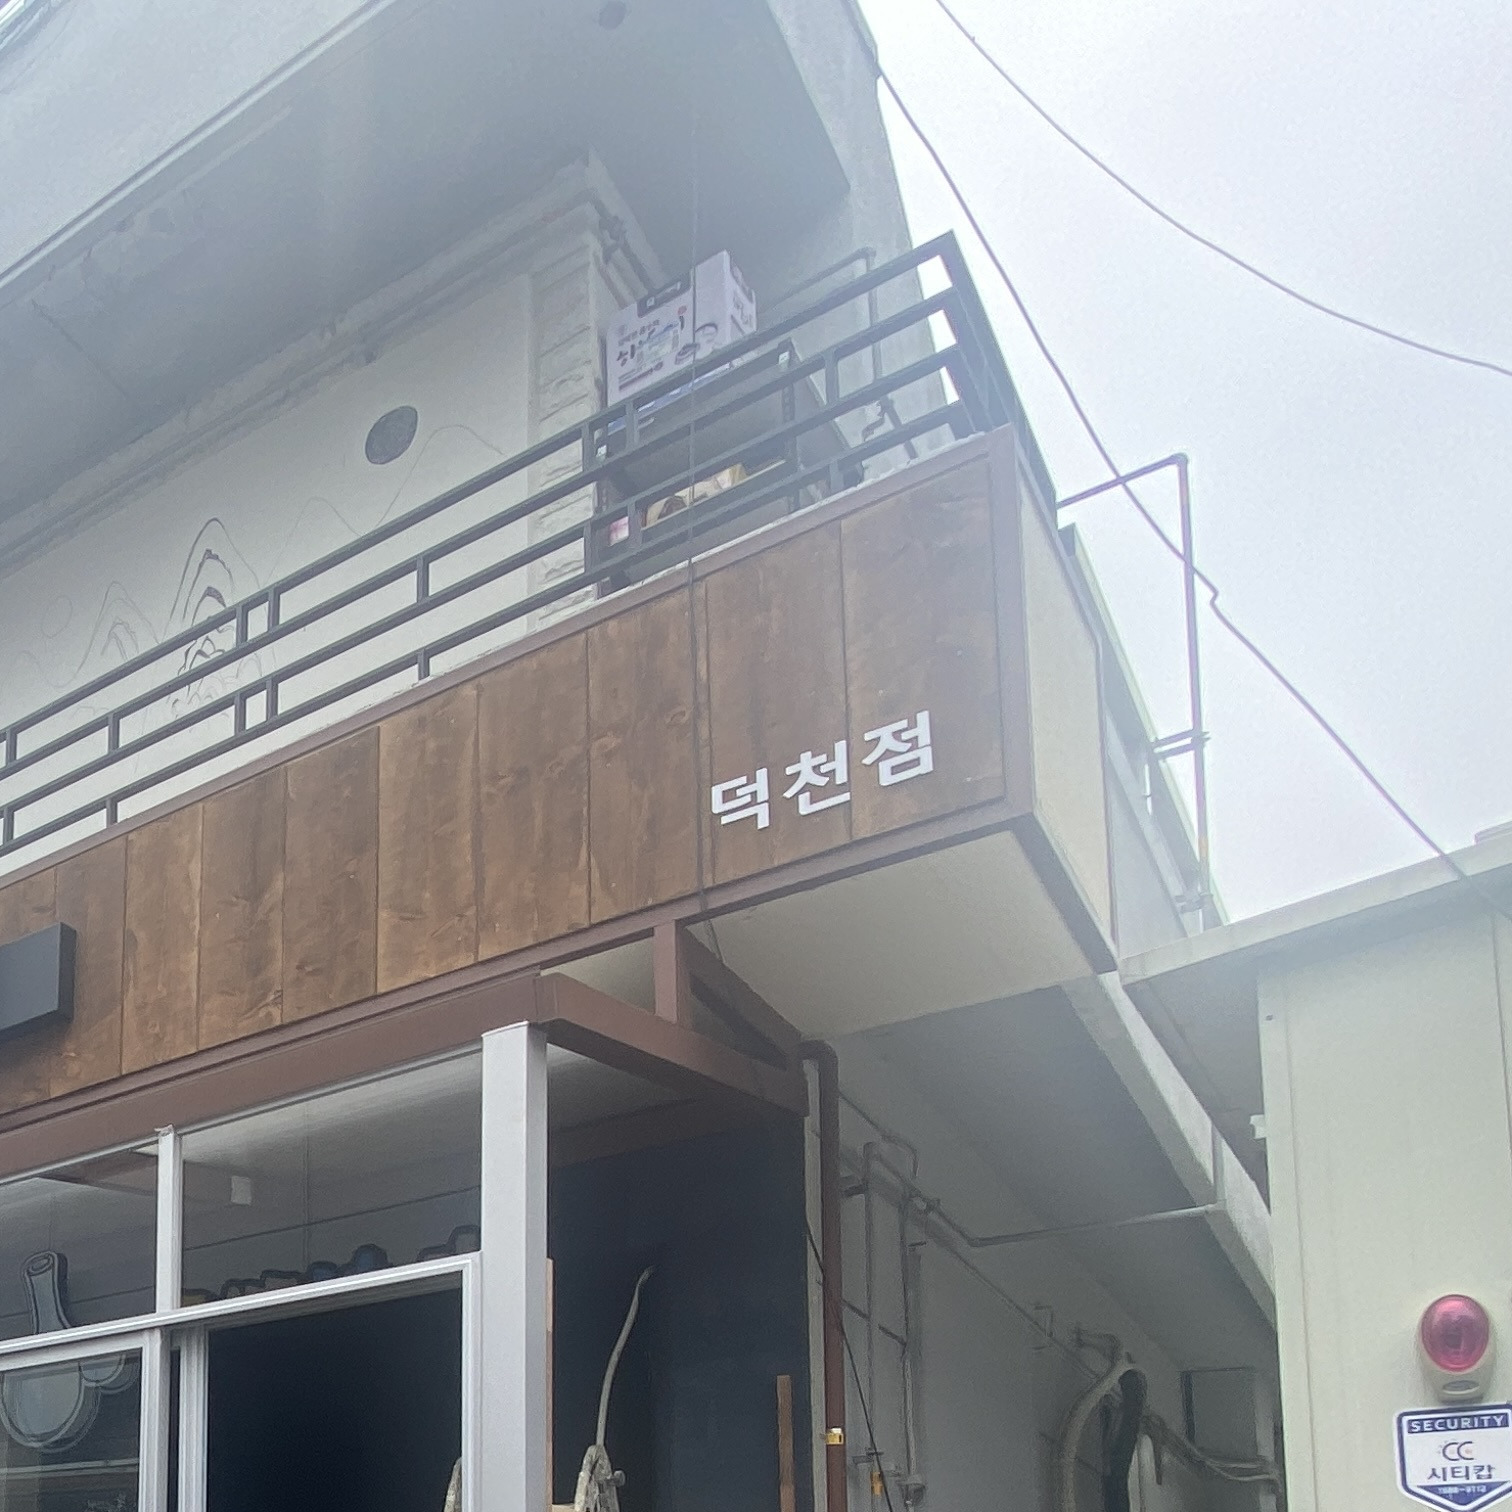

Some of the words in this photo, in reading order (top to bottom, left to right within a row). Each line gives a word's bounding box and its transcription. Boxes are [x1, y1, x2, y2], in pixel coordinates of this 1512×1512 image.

[711, 711, 935, 829] 덕천점
[1410, 1415, 1505, 1433] SECURITY
[1427, 1464, 1496, 1482] 시티캅
